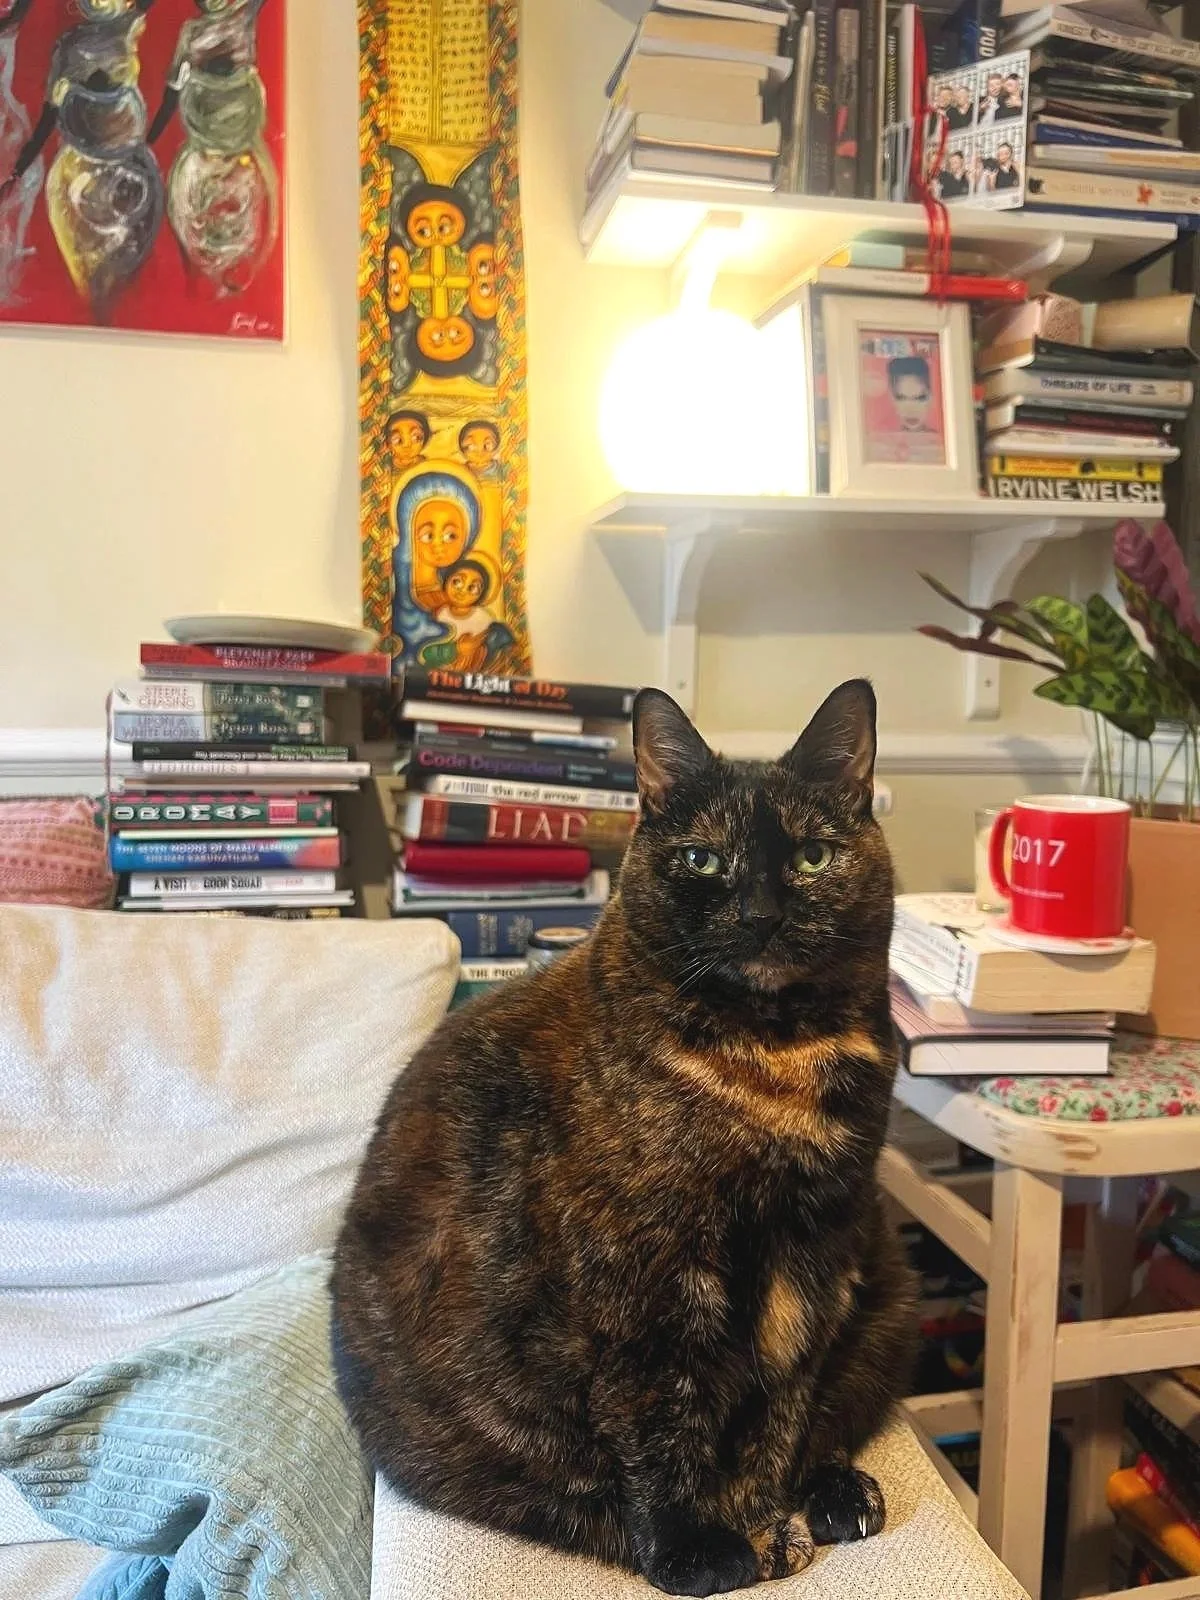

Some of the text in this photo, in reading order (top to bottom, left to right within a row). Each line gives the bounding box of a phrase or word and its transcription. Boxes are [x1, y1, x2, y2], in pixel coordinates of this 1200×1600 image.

[989, 477, 1161, 503] IRVINE WELSH
[428, 670, 462, 689] The
[464, 672, 511, 695] Light
[145, 686, 188, 697] STEEPLE
[138, 697, 195, 709] CHASING
[221, 721, 254, 736] Peter
[418, 751, 468, 769] Code
[470, 755, 563, 778] Dependent
[113, 804, 262, 822] OROMAY
[1012, 833, 1067, 867] 2017
[163, 877, 188, 890] VISIT
[203, 877, 229, 889] GOON
[231, 875, 263, 889] SQUAD
[469, 968, 489, 979] THE
